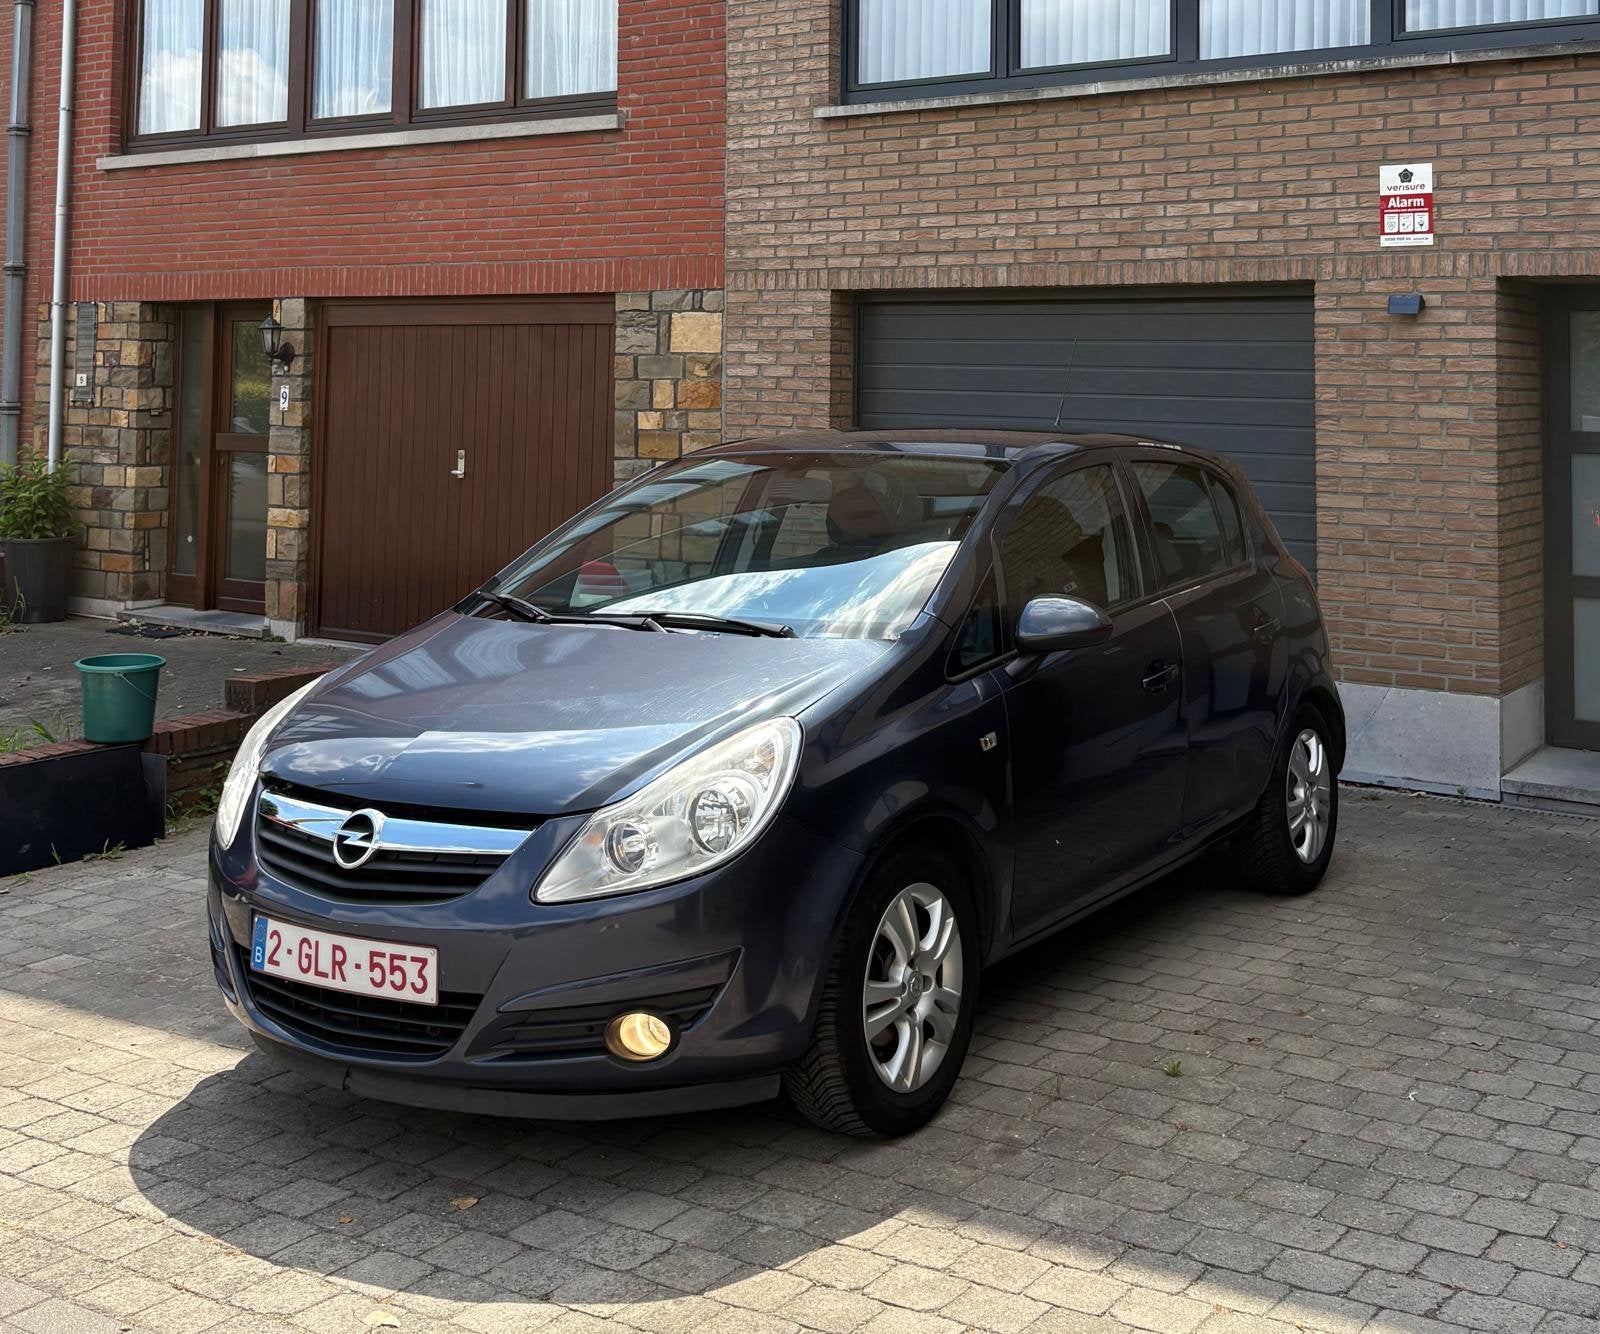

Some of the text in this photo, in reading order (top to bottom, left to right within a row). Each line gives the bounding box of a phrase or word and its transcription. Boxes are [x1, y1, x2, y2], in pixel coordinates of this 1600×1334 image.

[1387, 183, 1426, 191] verisure
[1387, 197, 1425, 208] Alarm
[281, 390, 288, 405] 9
[254, 929, 428, 994] B 2-GLR-553
